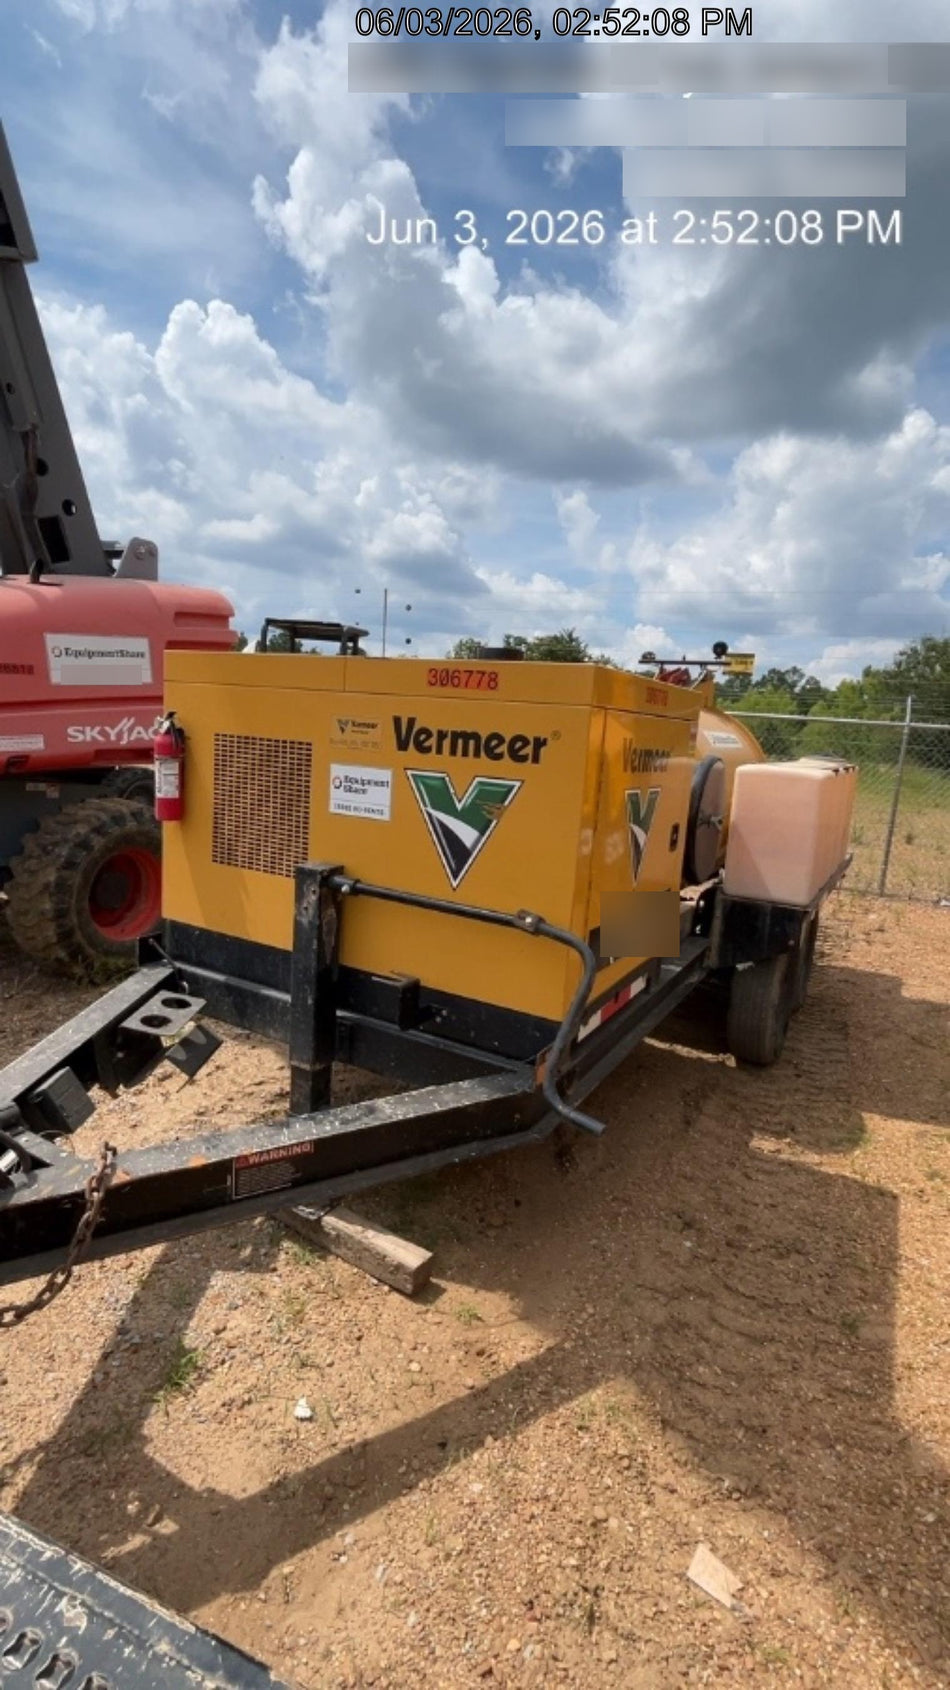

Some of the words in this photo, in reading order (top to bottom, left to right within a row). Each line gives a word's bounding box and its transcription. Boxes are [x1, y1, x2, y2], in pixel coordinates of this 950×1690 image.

[428, 668, 499, 690] 306778
[392, 715, 548, 764] Vermeer
[623, 737, 671, 773] Vermeer
[248, 1142, 311, 1165] WARNING
